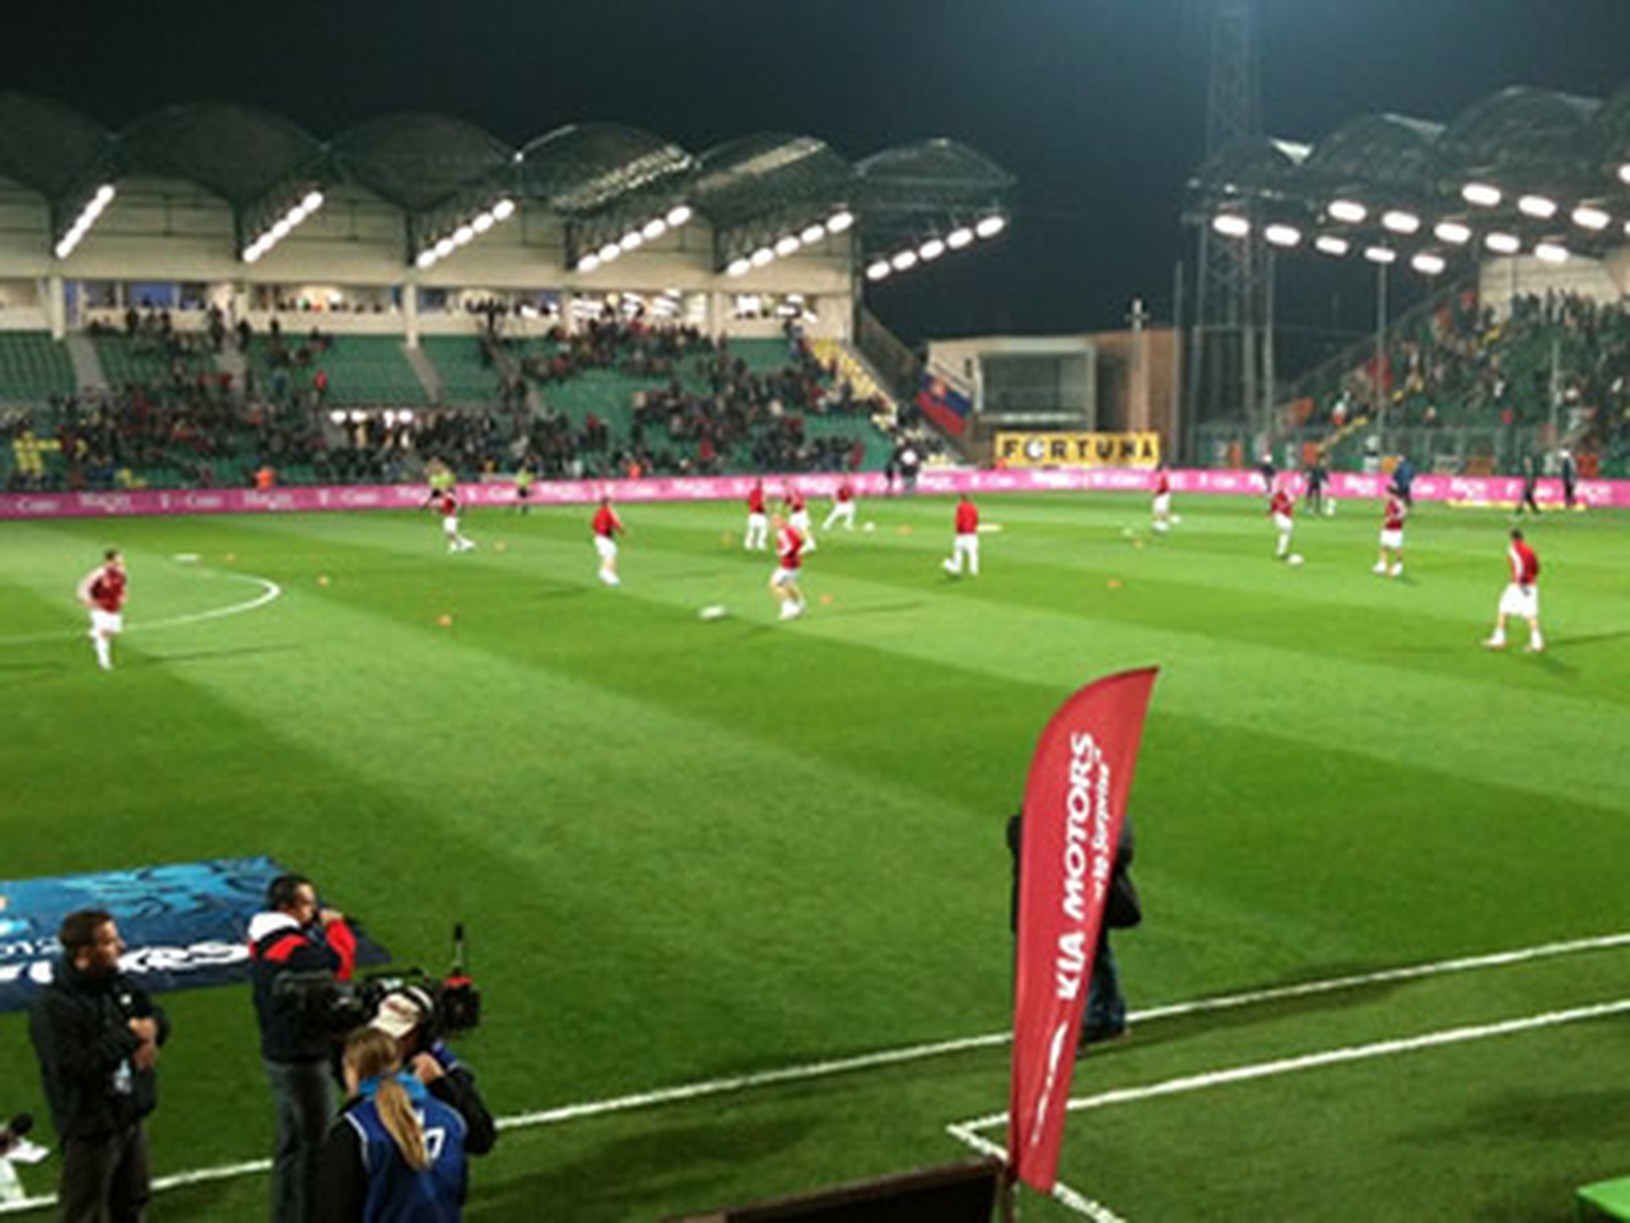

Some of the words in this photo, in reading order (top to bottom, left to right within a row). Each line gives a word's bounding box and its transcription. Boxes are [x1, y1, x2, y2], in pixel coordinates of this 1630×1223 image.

[1002, 437, 1154, 462] FORTUNA
[1062, 731, 1095, 920] MOTORS
[1056, 932, 1086, 1001] KIA
